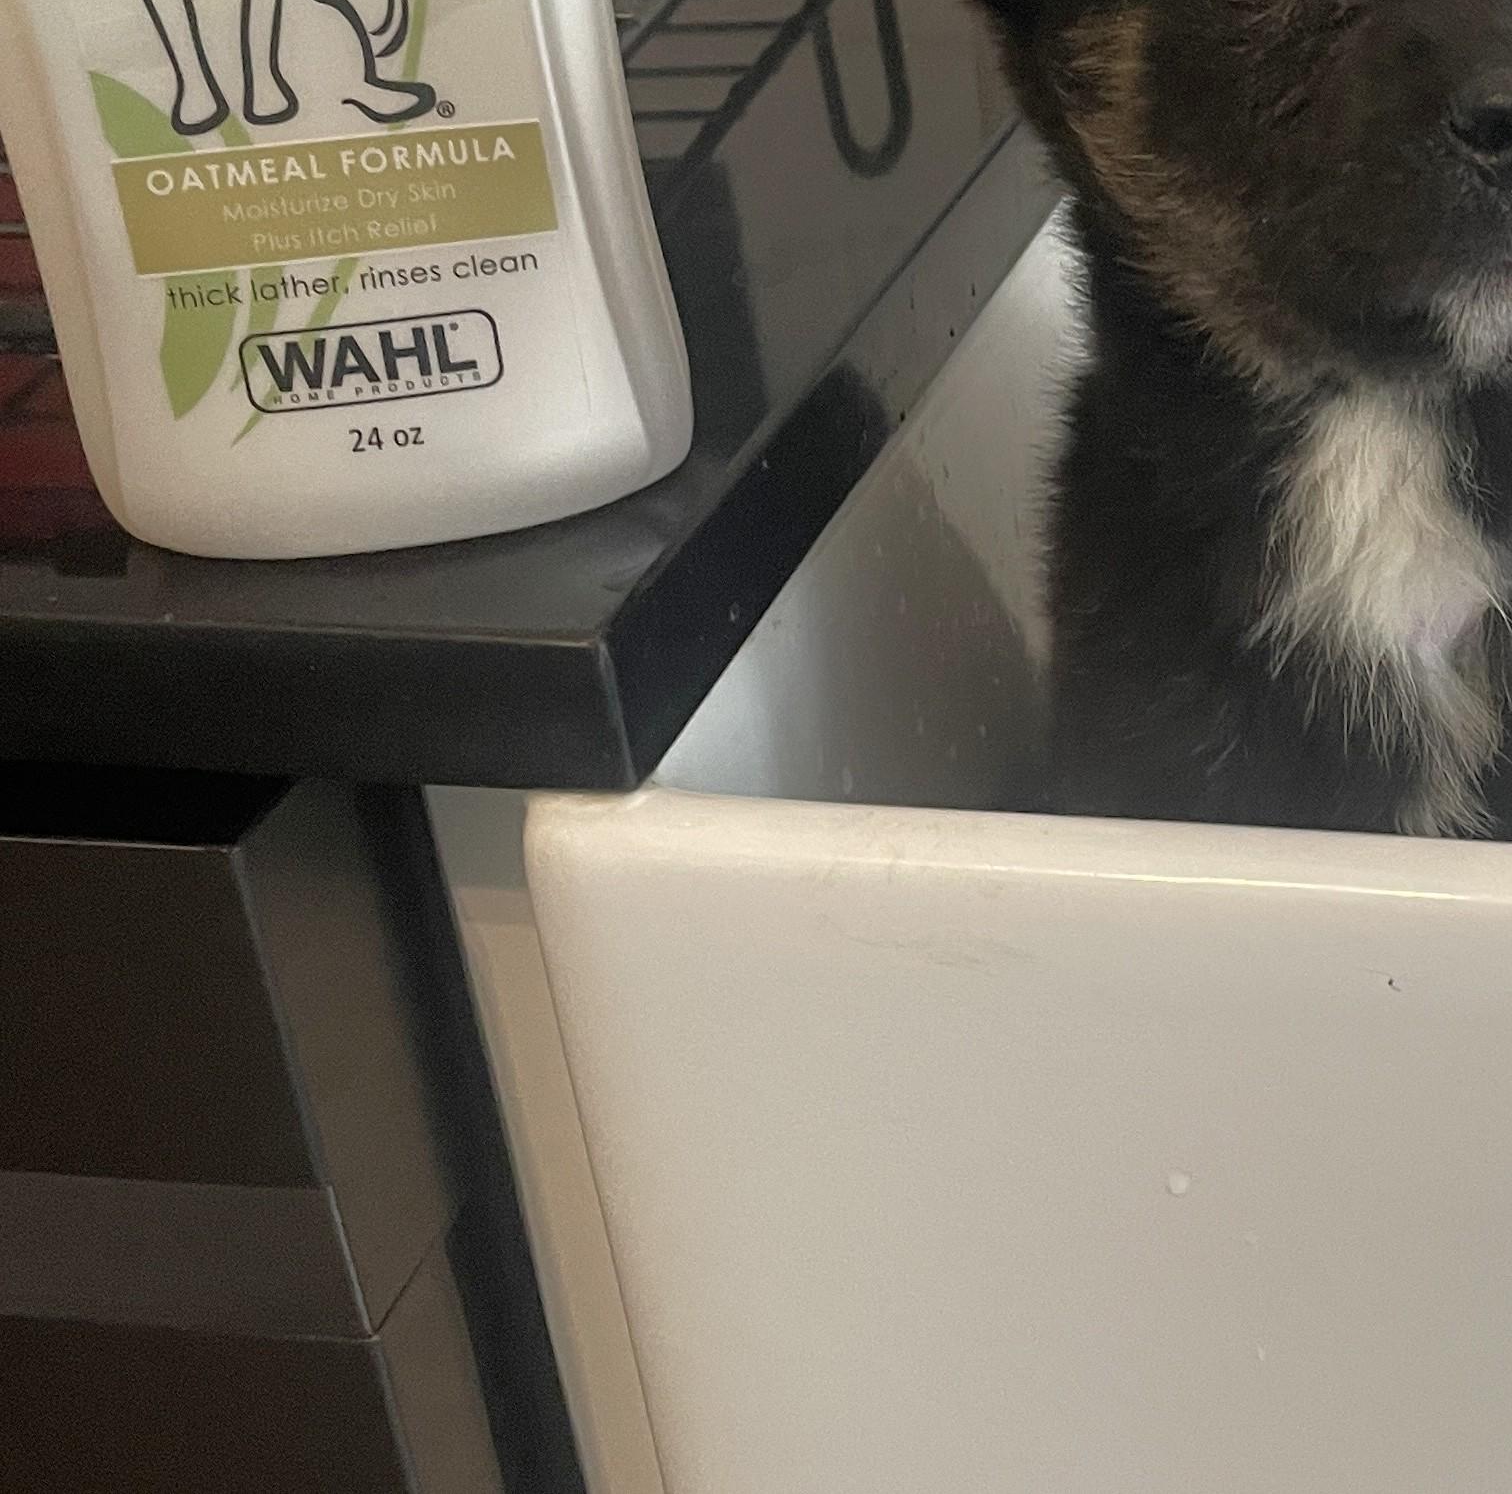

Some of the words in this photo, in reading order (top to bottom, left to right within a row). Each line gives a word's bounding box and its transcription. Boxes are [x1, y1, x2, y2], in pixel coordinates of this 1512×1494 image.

[146, 158, 326, 196] OATMEAL
[340, 137, 516, 177] FORMULA
[222, 192, 349, 223] Moisturize
[358, 185, 399, 210] Dry
[408, 179, 457, 203] Skin
[253, 232, 300, 254] Plus
[309, 226, 360, 249] Itch
[367, 216, 438, 241] Relief
[166, 280, 243, 310] thick
[359, 260, 442, 291] rinses
[452, 250, 539, 280] clean
[256, 324, 479, 393] WAHL
[273, 388, 336, 405] HOME
[355, 371, 481, 397] PRODUCTS
[348, 426, 384, 452] 24
[394, 426, 425, 447] oz
